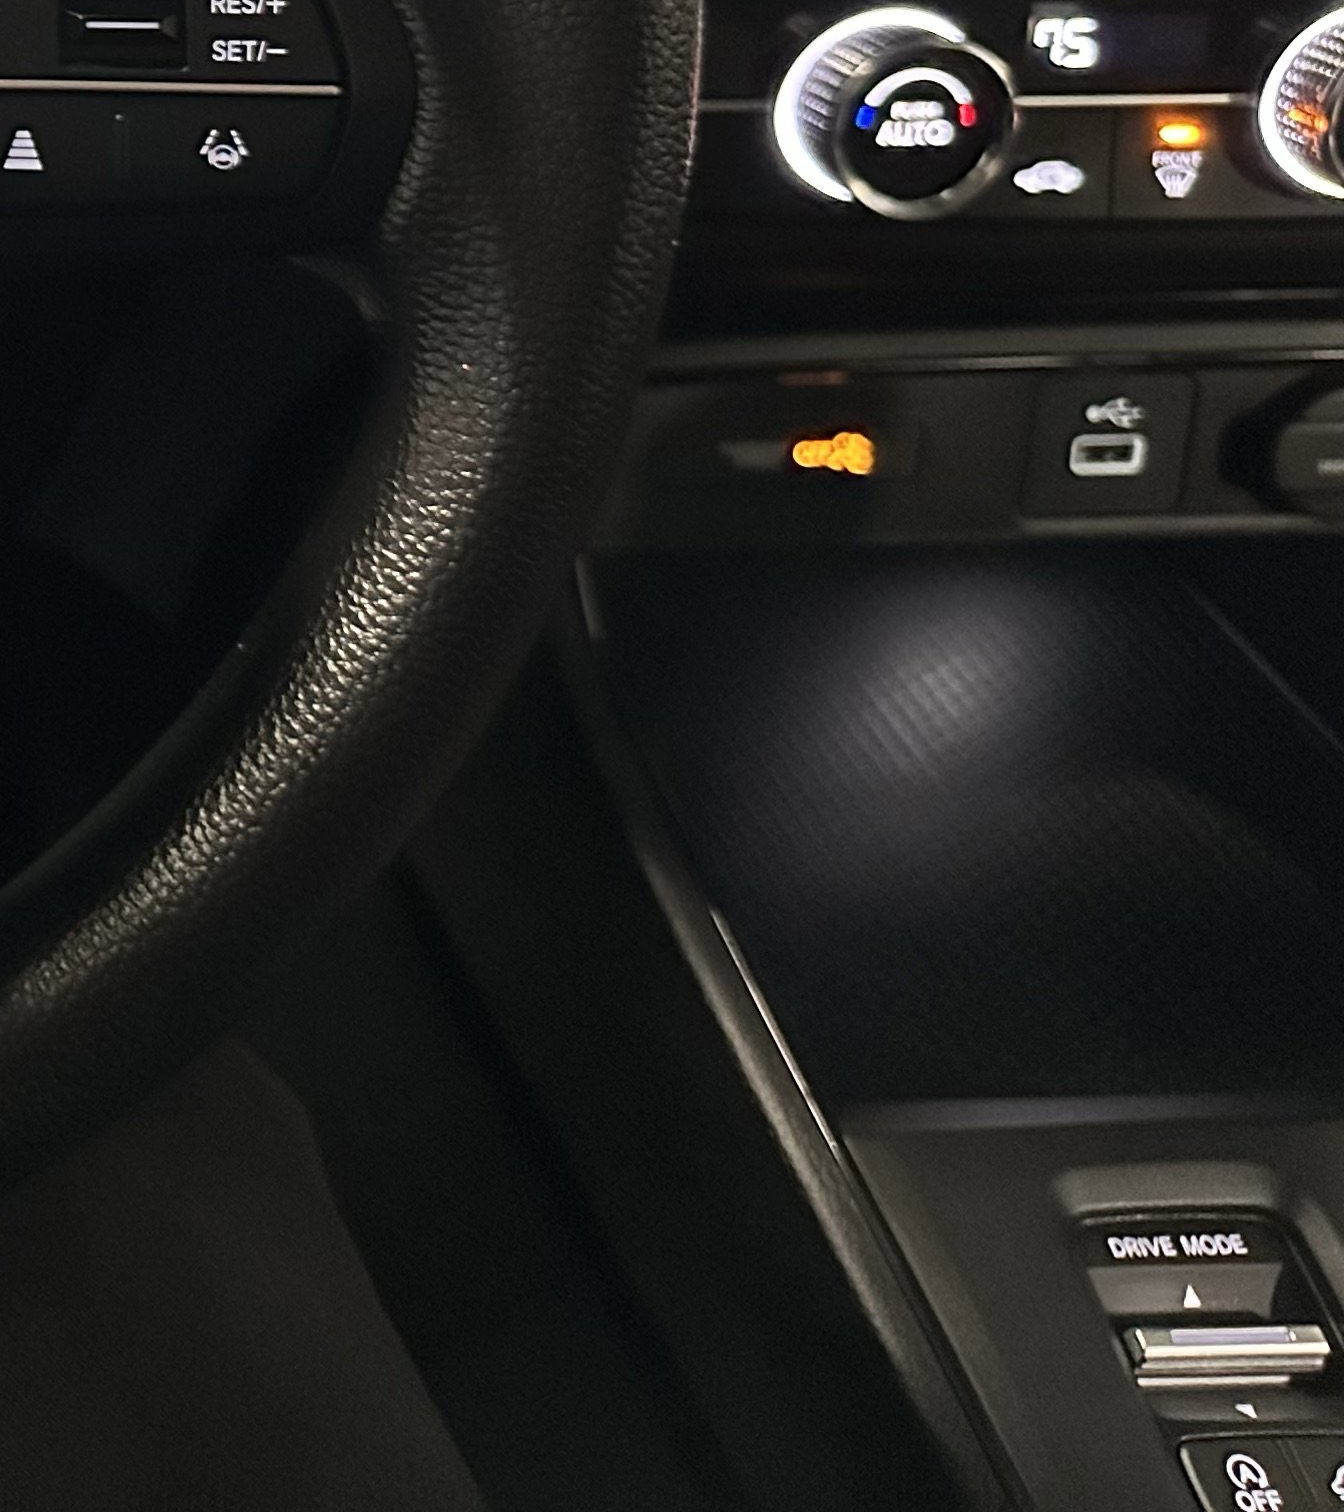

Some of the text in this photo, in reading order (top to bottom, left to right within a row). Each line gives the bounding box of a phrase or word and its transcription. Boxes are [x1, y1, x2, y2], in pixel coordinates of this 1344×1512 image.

[875, 118, 955, 147] AUTO
[1107, 1233, 1249, 1259] DRIVE MODE
[1234, 1487, 1284, 1512] OFF
